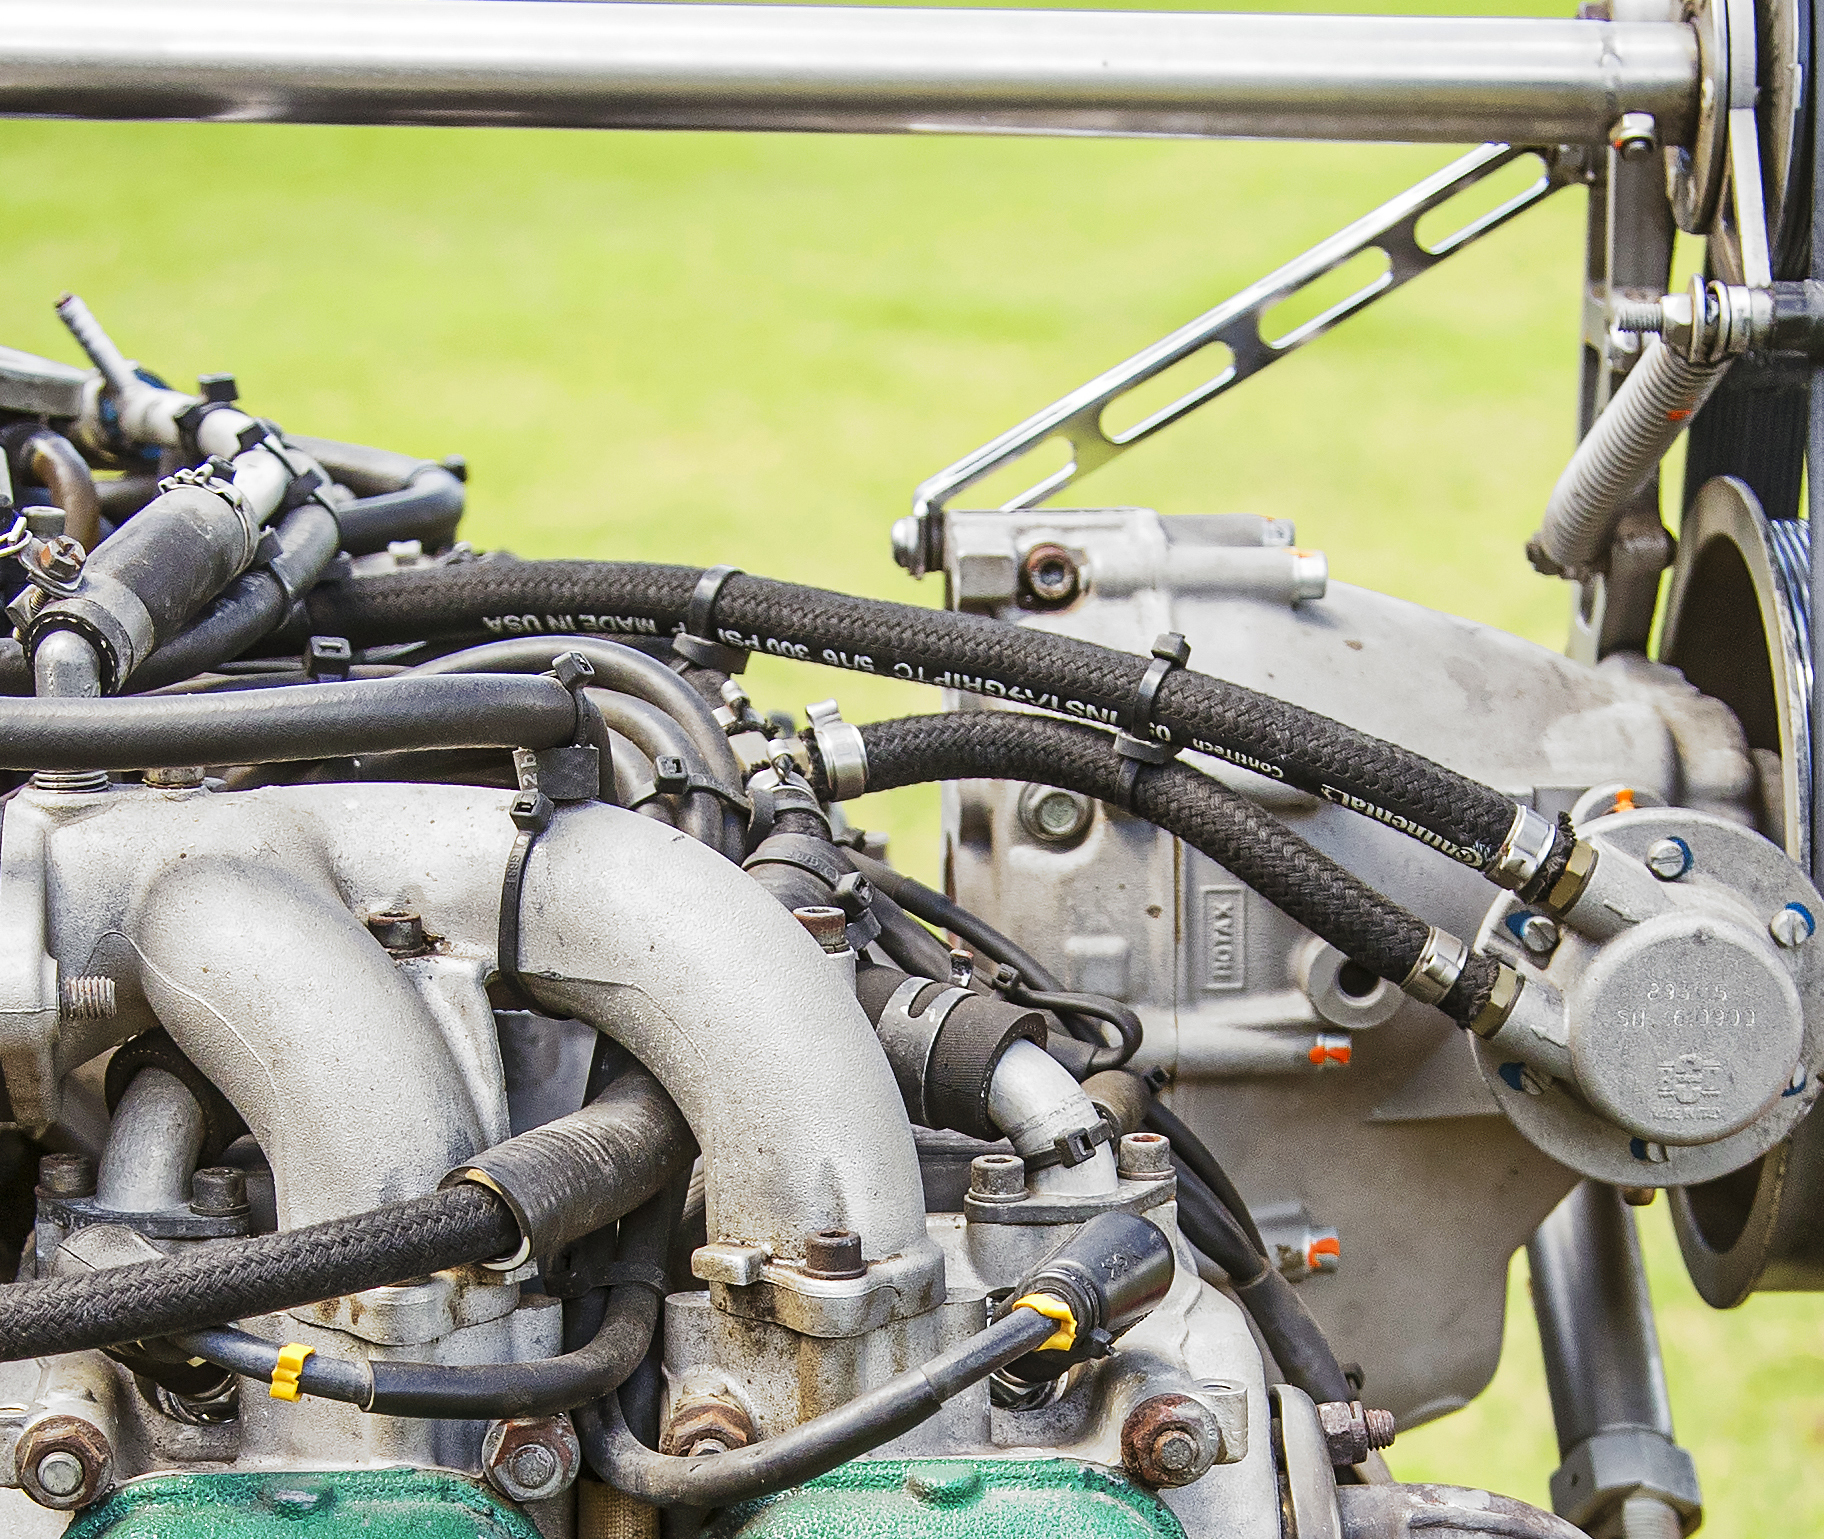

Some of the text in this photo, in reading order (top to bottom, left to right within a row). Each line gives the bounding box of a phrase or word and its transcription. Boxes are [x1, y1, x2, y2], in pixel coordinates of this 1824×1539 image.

[482, 614, 542, 633] USA
[548, 614, 577, 631] IN
[577, 613, 657, 635] MADE
[766, 636, 812, 661] 300
[1192, 737, 1285, 780] ContiTech
